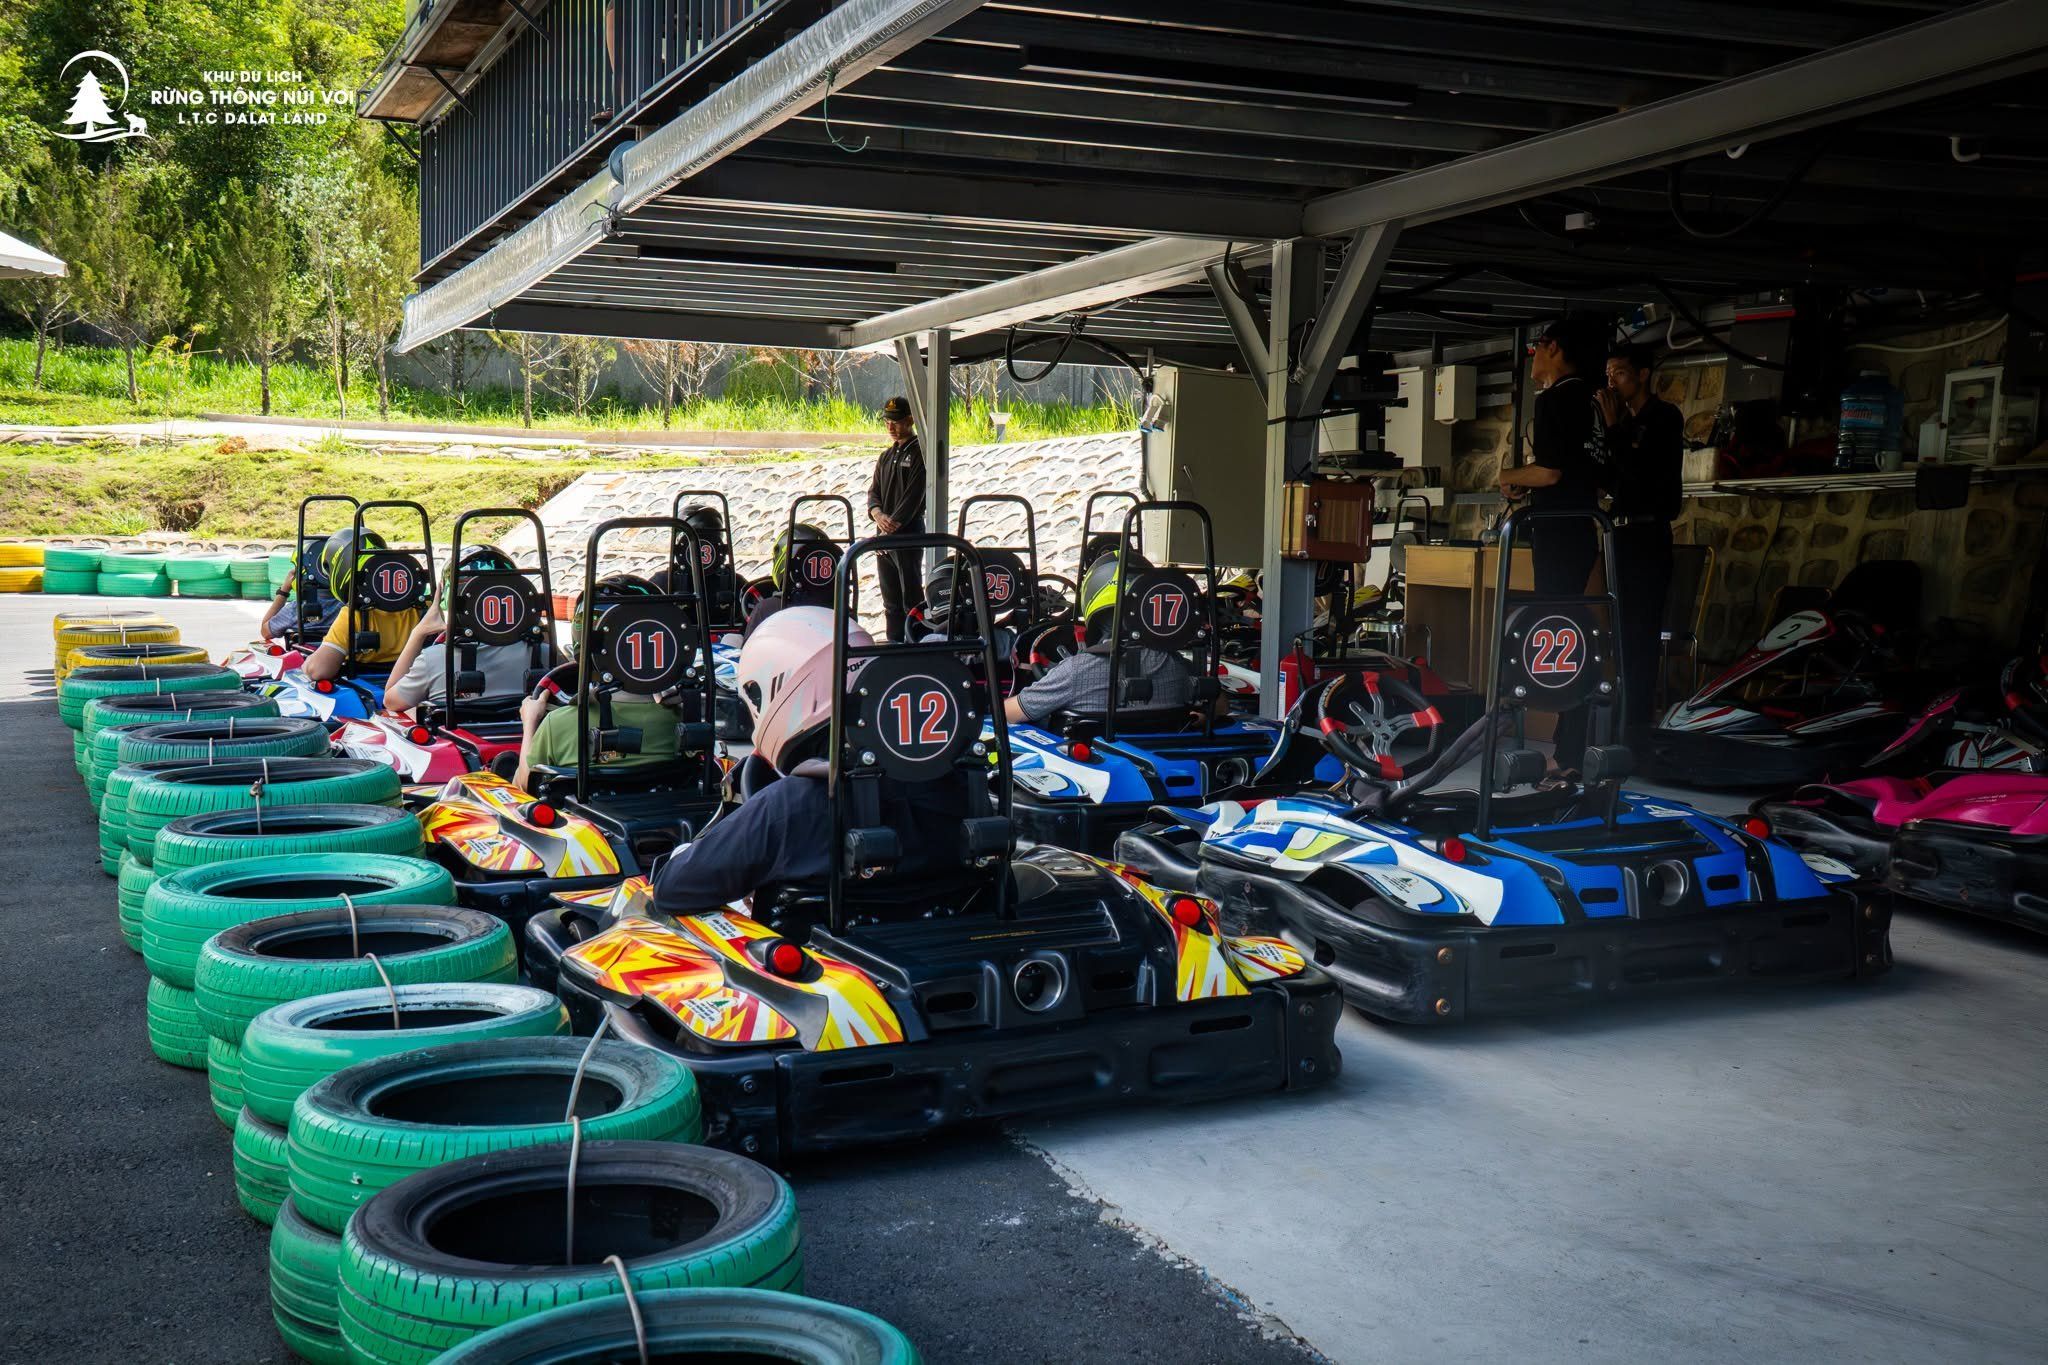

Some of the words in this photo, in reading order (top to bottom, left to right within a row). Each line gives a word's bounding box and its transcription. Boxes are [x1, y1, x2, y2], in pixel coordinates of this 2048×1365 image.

[701, 545, 712, 564] 3
[808, 556, 832, 578] 18
[379, 569, 407, 594] 16
[483, 595, 514, 625] 01
[1149, 593, 1183, 626] 17
[626, 631, 664, 669] 11
[1532, 628, 1577, 674] 22
[890, 690, 948, 745] 12
